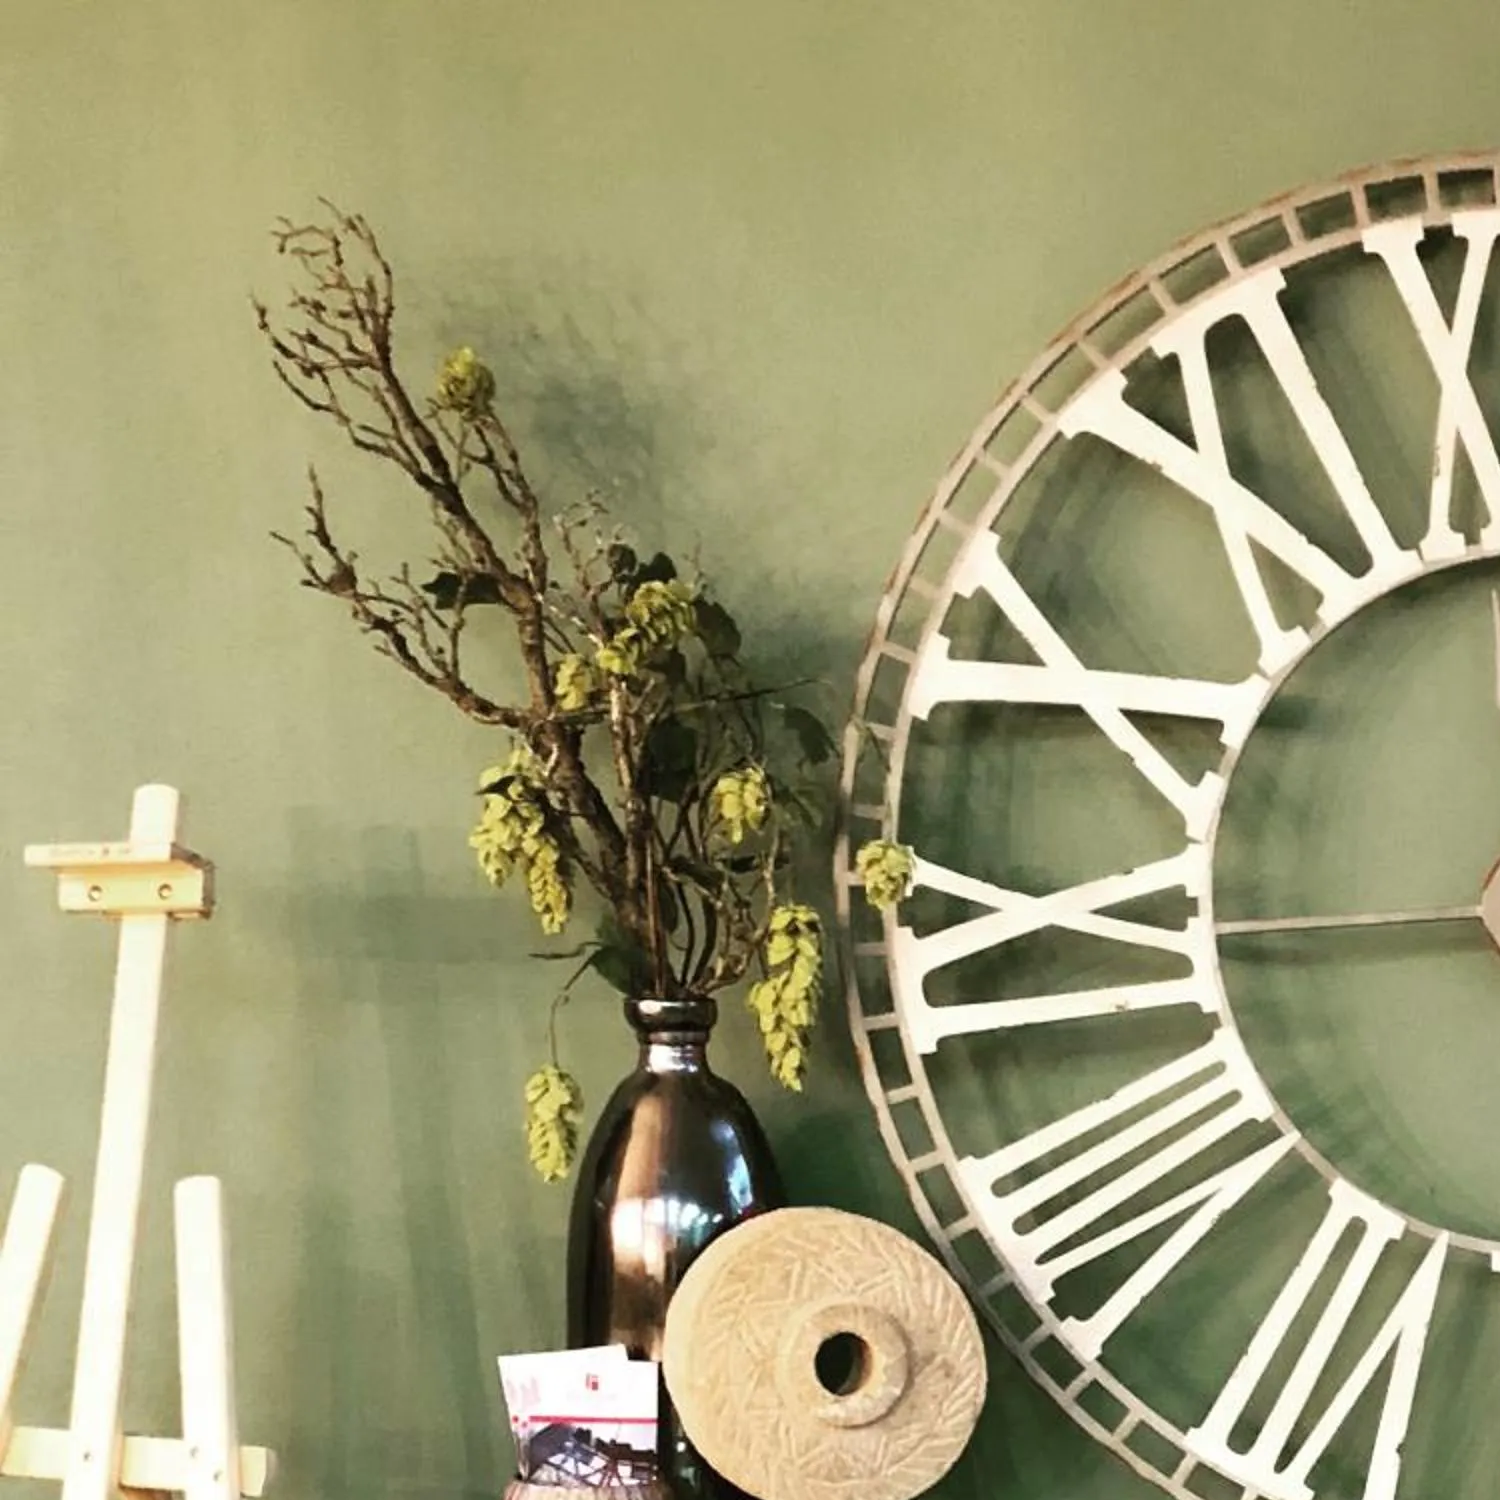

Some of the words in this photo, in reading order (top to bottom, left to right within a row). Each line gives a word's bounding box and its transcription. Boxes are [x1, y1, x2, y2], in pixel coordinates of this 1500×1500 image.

[1056, 266, 1424, 677] XI
[908, 529, 1270, 841] X
[893, 843, 1222, 1054] IX
[958, 1025, 1301, 1361] VIII
